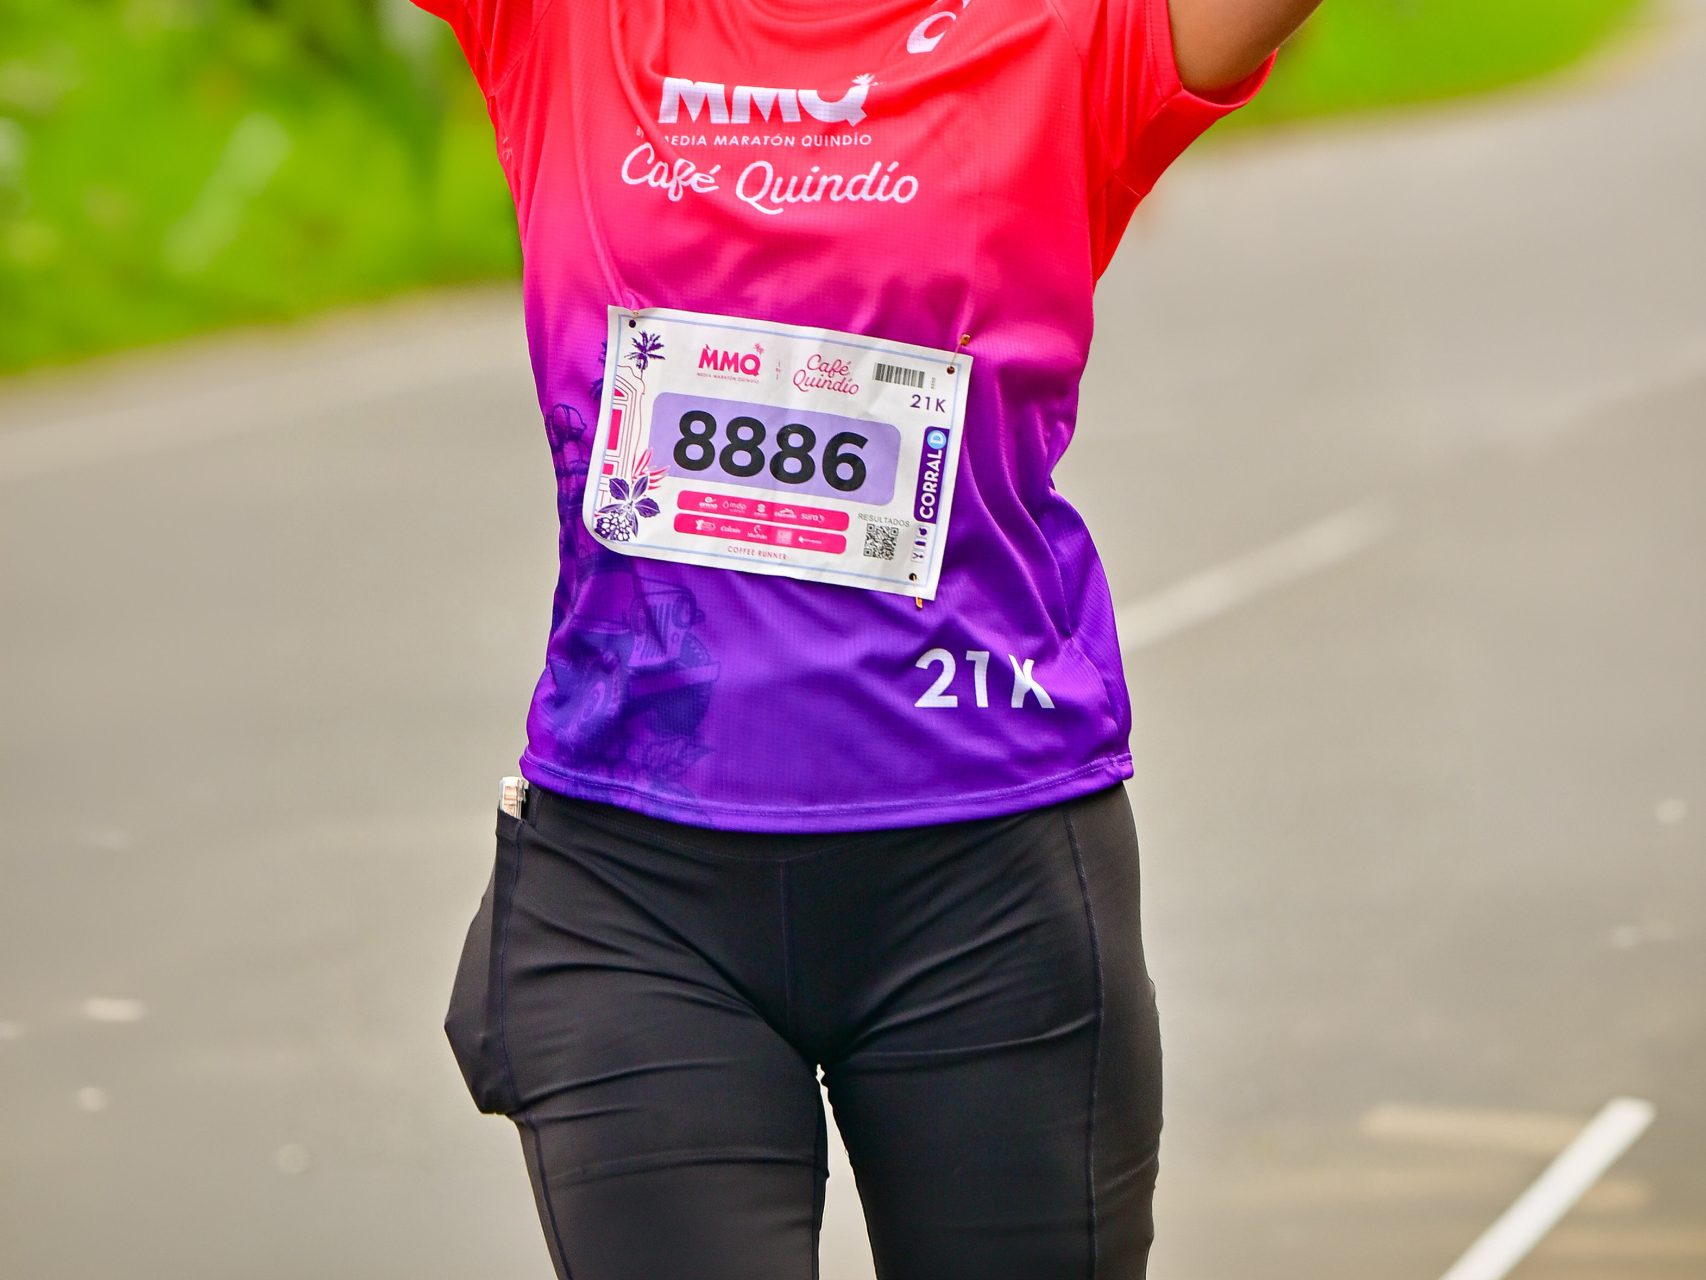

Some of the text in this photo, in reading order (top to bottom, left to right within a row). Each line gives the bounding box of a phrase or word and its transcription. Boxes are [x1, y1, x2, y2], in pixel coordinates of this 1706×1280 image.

[658, 74, 876, 127] MMQ
[664, 132, 872, 147] EDIA MARATÓN QUINDÍO
[621, 142, 919, 215] Café Quindío
[697, 345, 761, 377] MMQ
[806, 354, 852, 378] Café
[792, 369, 860, 395] Quindío
[673, 410, 869, 492] 8886
[919, 449, 943, 519] CORRAL
[858, 512, 910, 528] RESULTADOS
[728, 545, 788, 560] COFFEE RUNNER
